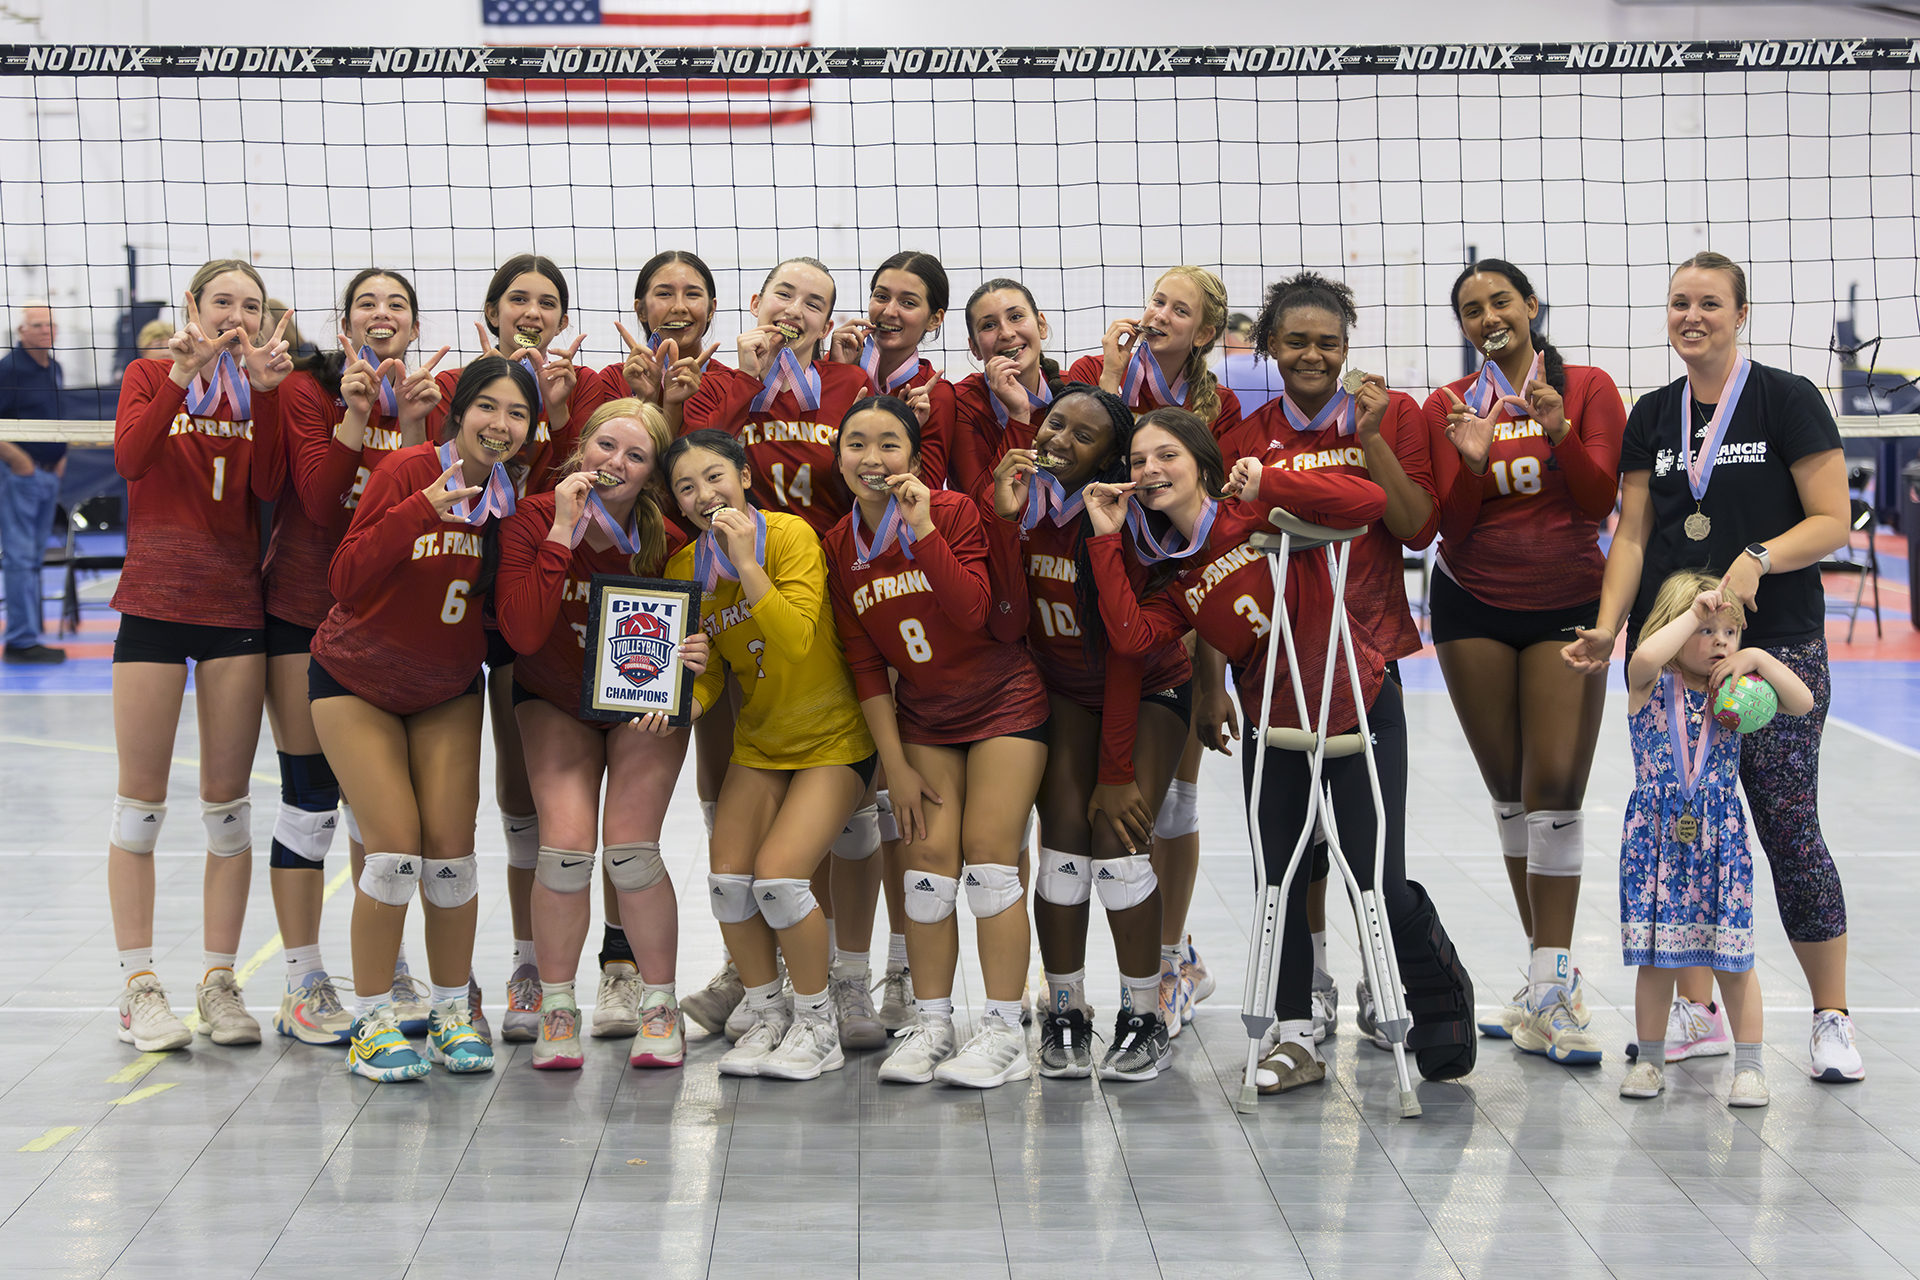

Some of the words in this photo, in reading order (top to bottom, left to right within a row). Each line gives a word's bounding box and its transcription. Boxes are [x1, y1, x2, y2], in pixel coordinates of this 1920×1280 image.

[24, 48, 68, 72] NO
[69, 48, 150, 72] DINX
[195, 48, 238, 72] NO
[240, 48, 322, 72] DINX
[368, 48, 412, 72] NO
[413, 48, 494, 72] DINX
[539, 49, 583, 73] NO
[584, 49, 666, 73] DINX
[710, 50, 754, 74] NO
[756, 50, 836, 74] DINX
[880, 49, 925, 73] NO
[926, 49, 1007, 73] DINX
[1053, 48, 1098, 72] NO
[1098, 48, 1178, 72] DINX
[1224, 46, 1268, 72] NO
[1268, 46, 1350, 72] DINX
[1394, 46, 1438, 70] NO
[1439, 46, 1521, 70] DINX
[1565, 43, 1610, 69] NO
[1610, 43, 1693, 69] DINX
[1736, 41, 1780, 67] NO
[1780, 41, 1864, 67] DINX
[212, 456, 226, 502] 1
[771, 462, 812, 506] 14
[1492, 456, 1542, 495] 18
[411, 532, 440, 560] ST.
[440, 579, 470, 624] 6
[612, 600, 677, 617] CIVT
[854, 584, 874, 616] ST.
[1184, 582, 1206, 616] ST.
[1036, 598, 1081, 637] 10
[1234, 594, 1272, 639] 3
[616, 640, 667, 662] VOLLEYBALL
[899, 618, 934, 664] 8
[606, 686, 668, 704] CHAMPIONS
